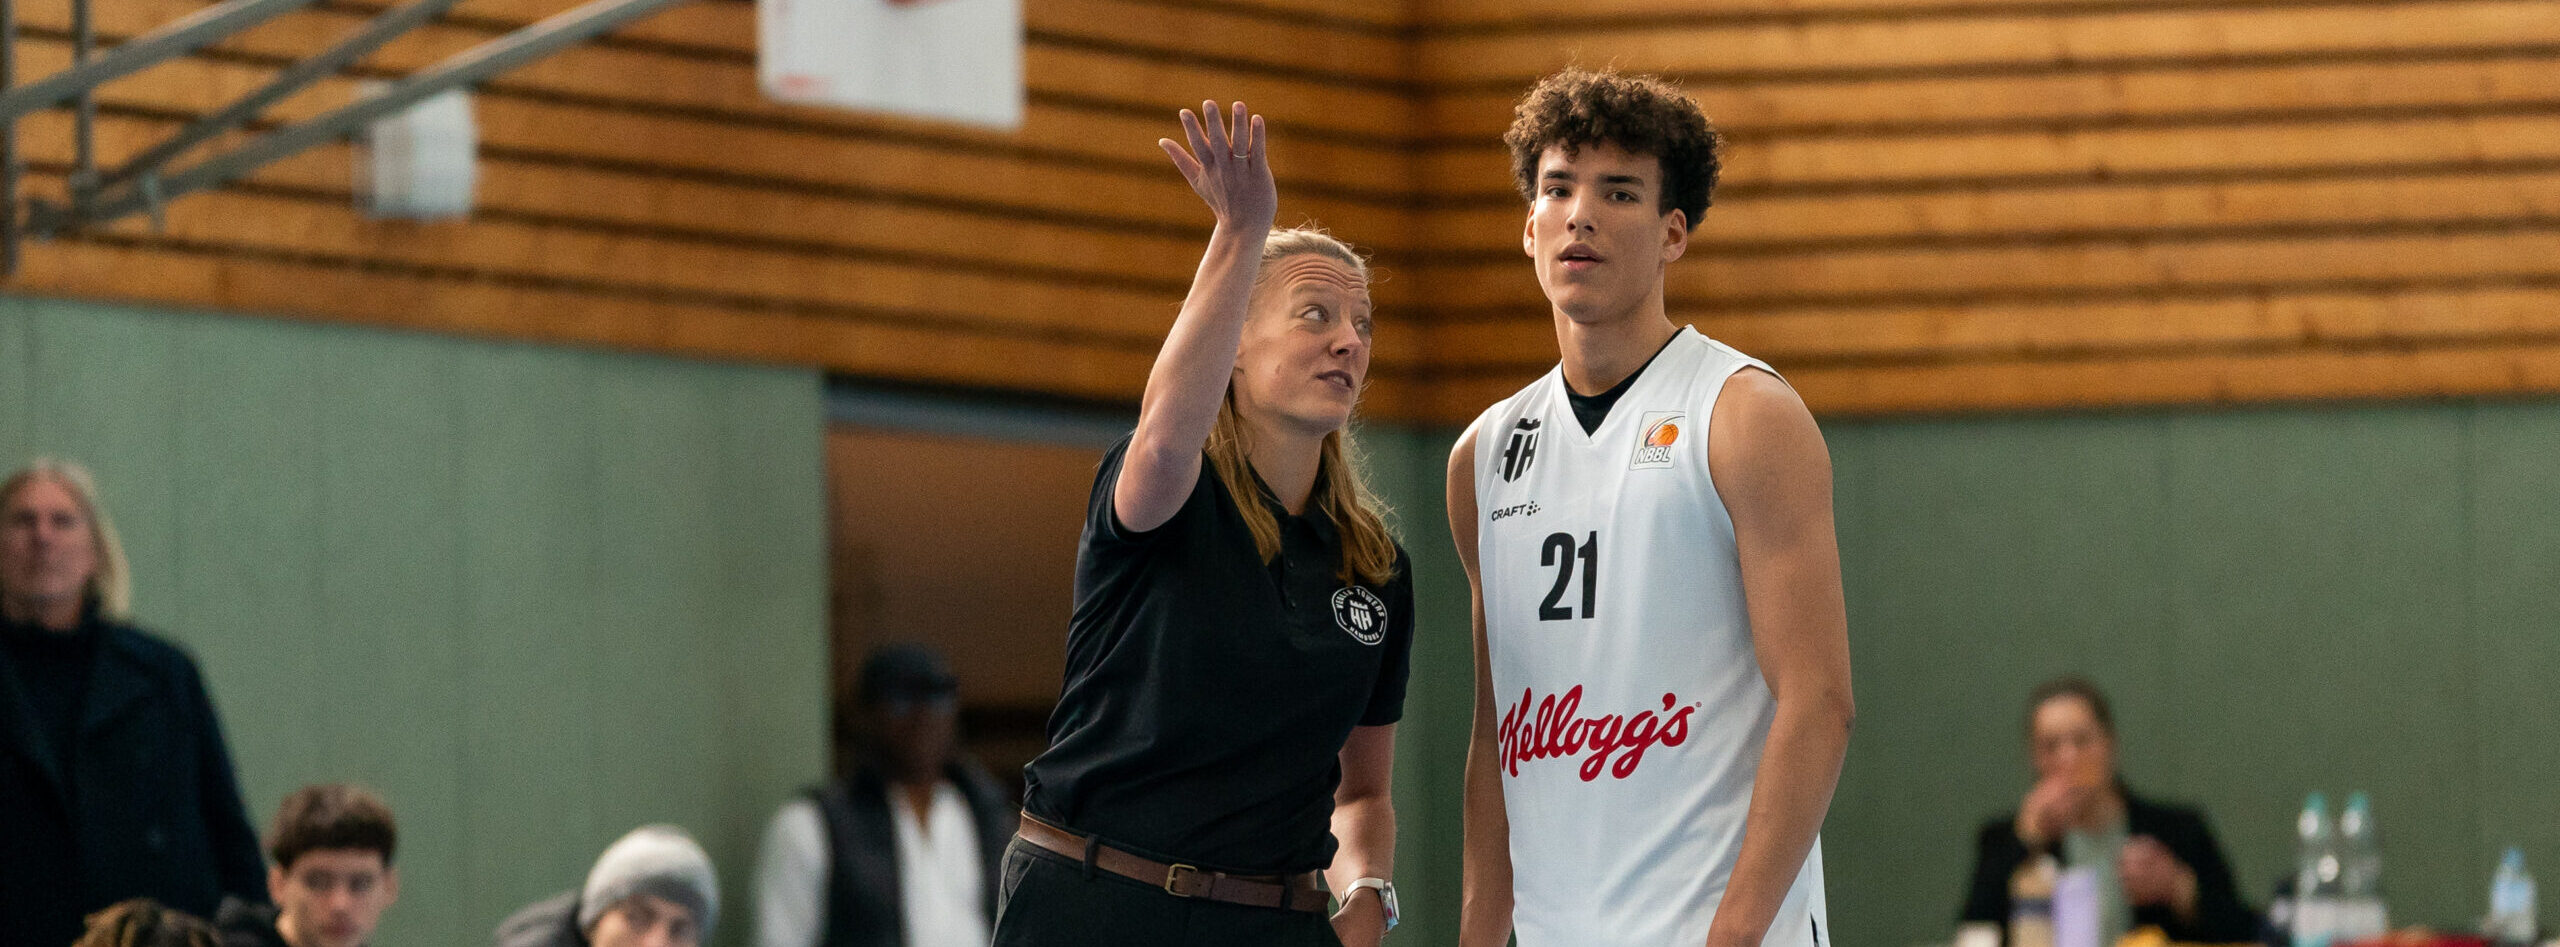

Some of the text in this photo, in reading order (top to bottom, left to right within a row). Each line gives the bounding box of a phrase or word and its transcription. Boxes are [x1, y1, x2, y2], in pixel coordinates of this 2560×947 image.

[1634, 447, 1671, 465] NBBL
[1491, 504, 1527, 521] CRAFT
[1539, 530, 1598, 621] 21
[1356, 588, 1385, 617] TOWERS
[1500, 684, 1695, 782] Kellogg's
